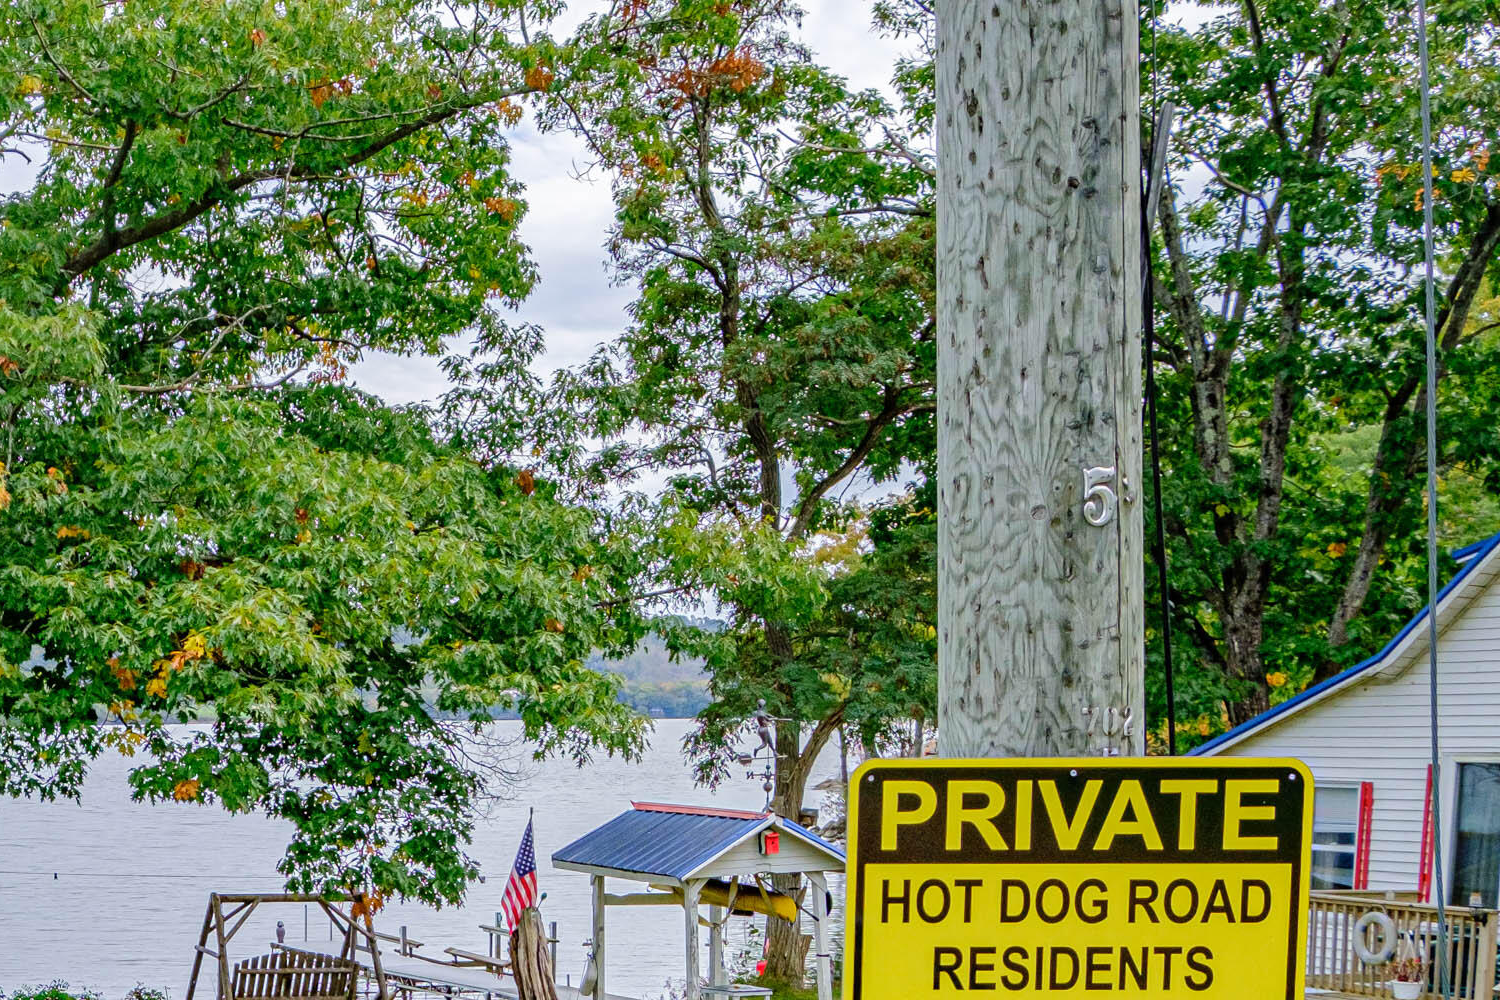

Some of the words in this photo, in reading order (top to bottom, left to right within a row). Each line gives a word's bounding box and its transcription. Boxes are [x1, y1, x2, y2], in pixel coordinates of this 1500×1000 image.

[1083, 466, 1117, 527] 5
[881, 779, 1280, 851] PRIVATE
[881, 879, 983, 924] HOT
[1000, 878, 1108, 924] DOG
[1128, 878, 1272, 924] ROAD
[933, 946, 1215, 991] RESIDENTS
